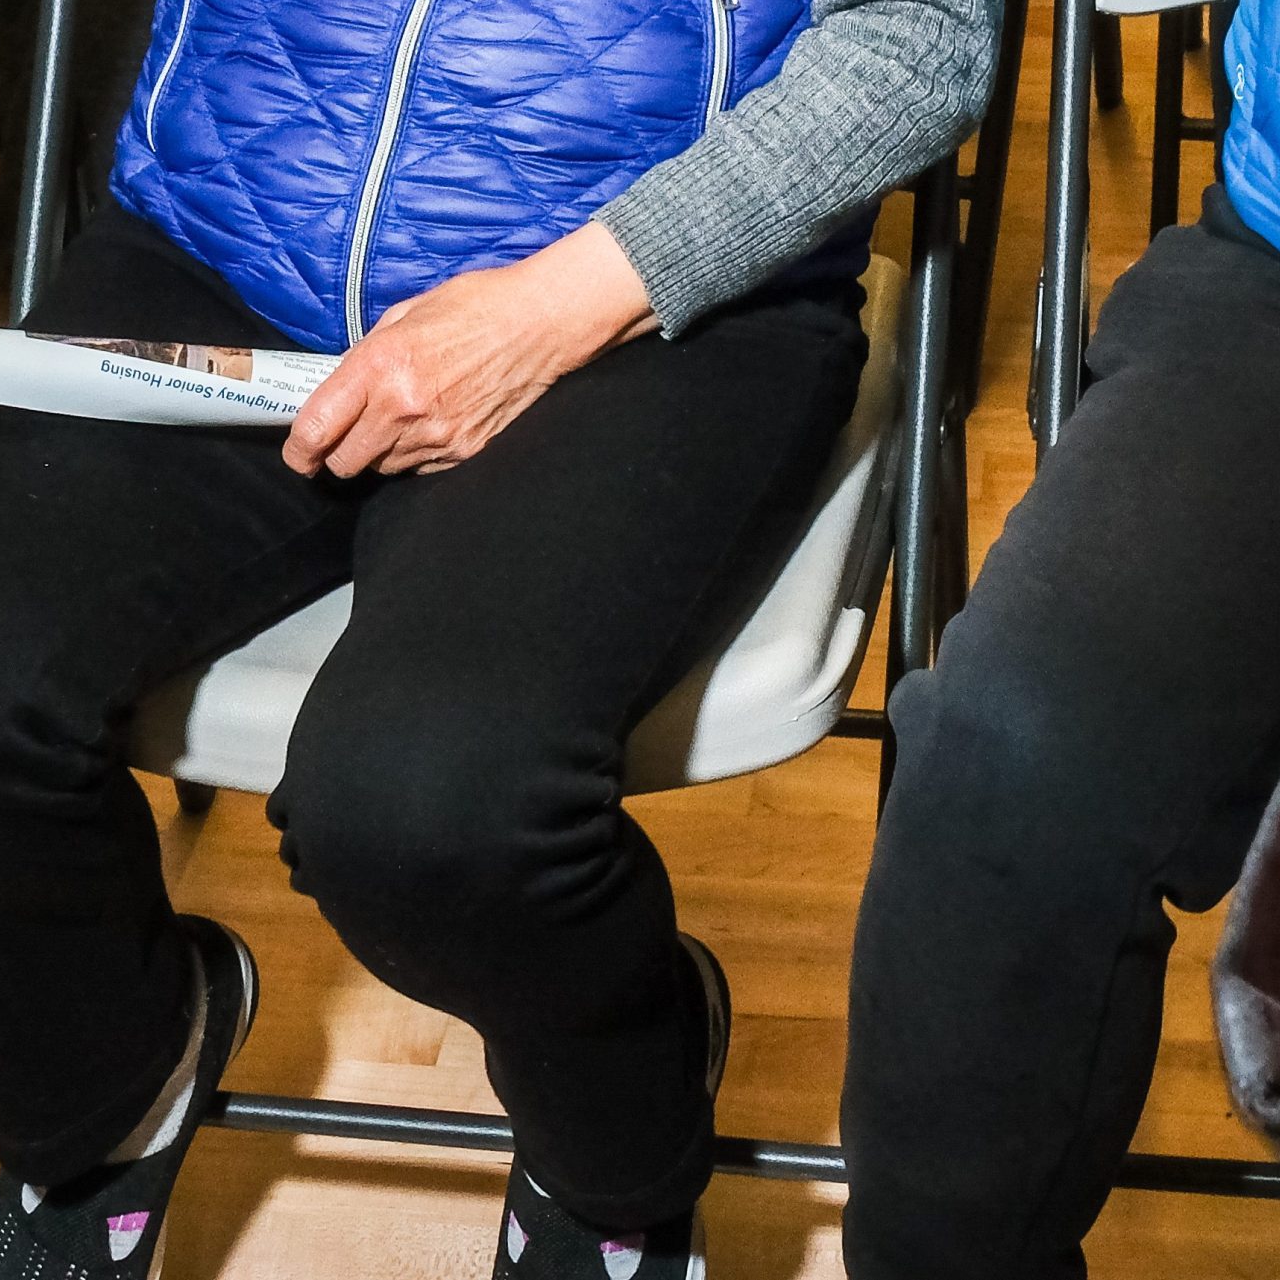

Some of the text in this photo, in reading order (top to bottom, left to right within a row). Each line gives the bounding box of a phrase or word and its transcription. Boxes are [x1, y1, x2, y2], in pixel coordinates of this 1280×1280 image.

[100, 359, 163, 388] Housing
[273, 379, 296, 392] TNDC
[165, 377, 214, 399] Senior
[216, 386, 280, 413] Highway
